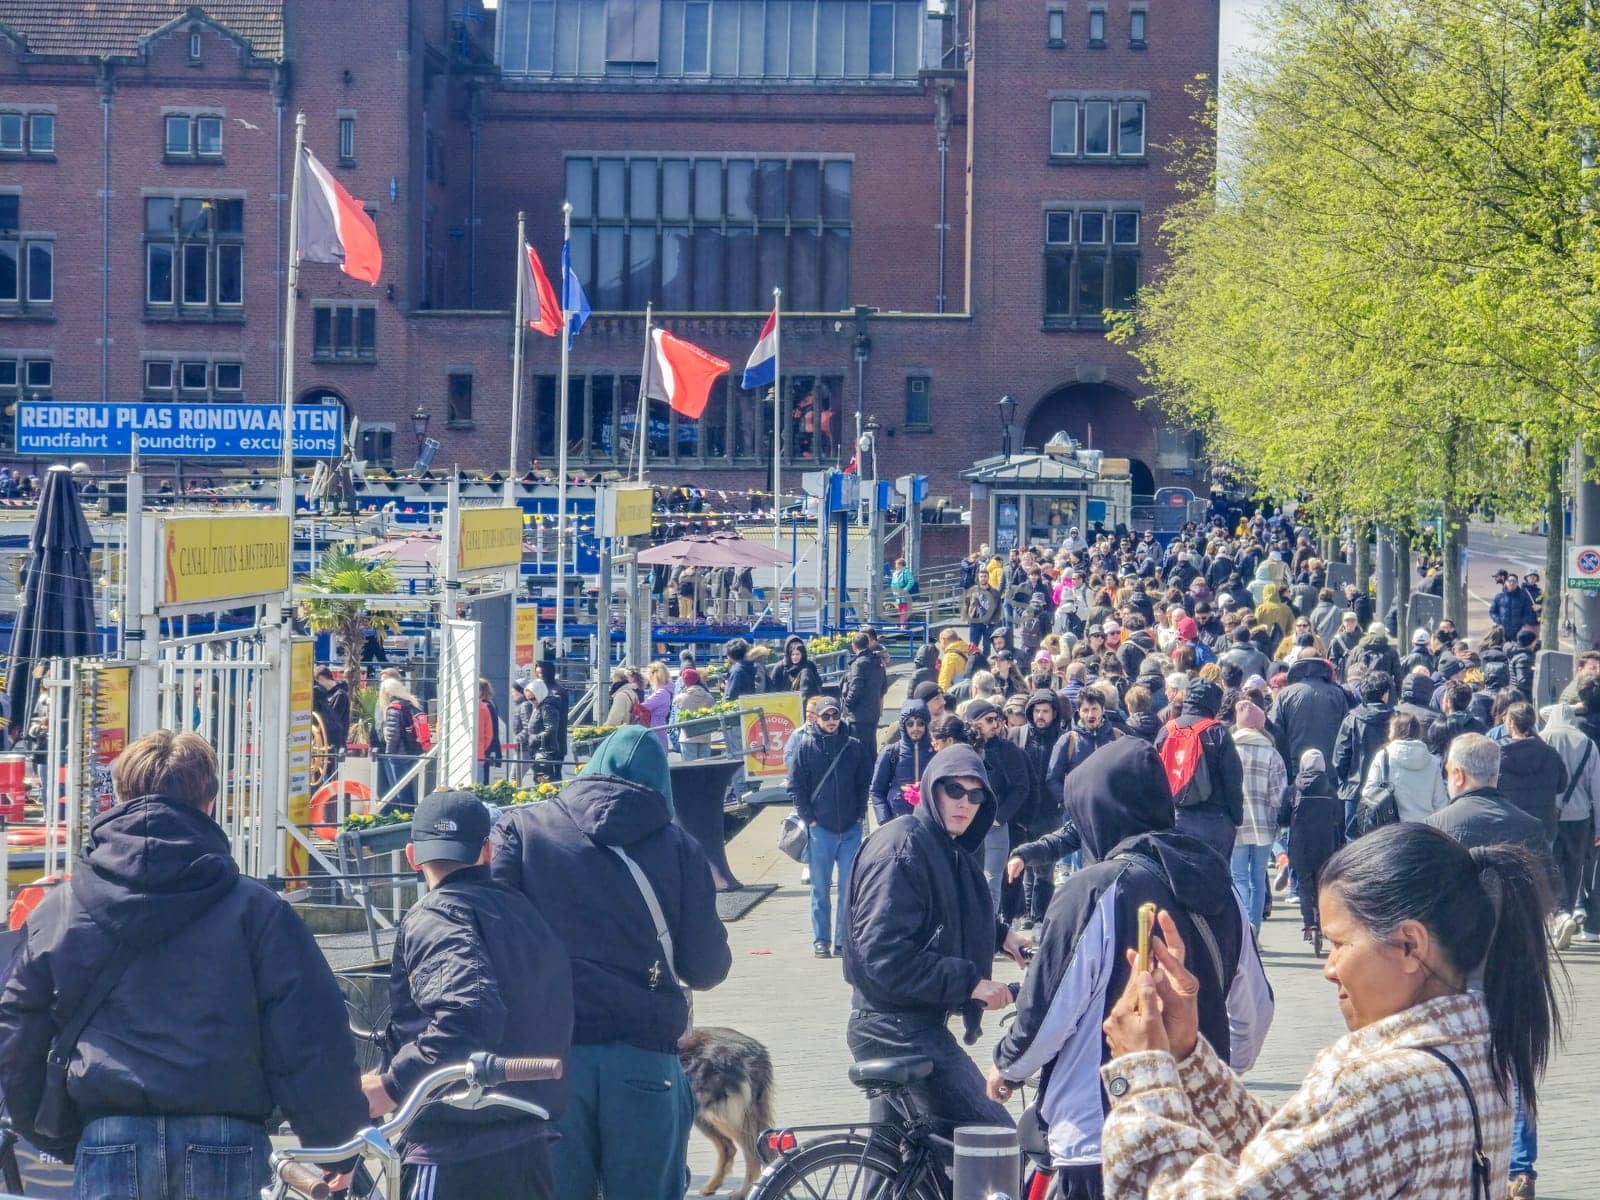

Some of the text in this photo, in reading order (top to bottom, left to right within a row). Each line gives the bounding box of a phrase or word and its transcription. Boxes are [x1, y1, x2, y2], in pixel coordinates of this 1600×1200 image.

[21, 406, 338, 431] REDERIJ PLAS RONDVAARTEN
[21, 432, 109, 448] rundfahrt
[133, 433, 217, 453] oundtrip
[179, 546, 208, 577] CANAL
[239, 541, 287, 572] AMSTERDAM
